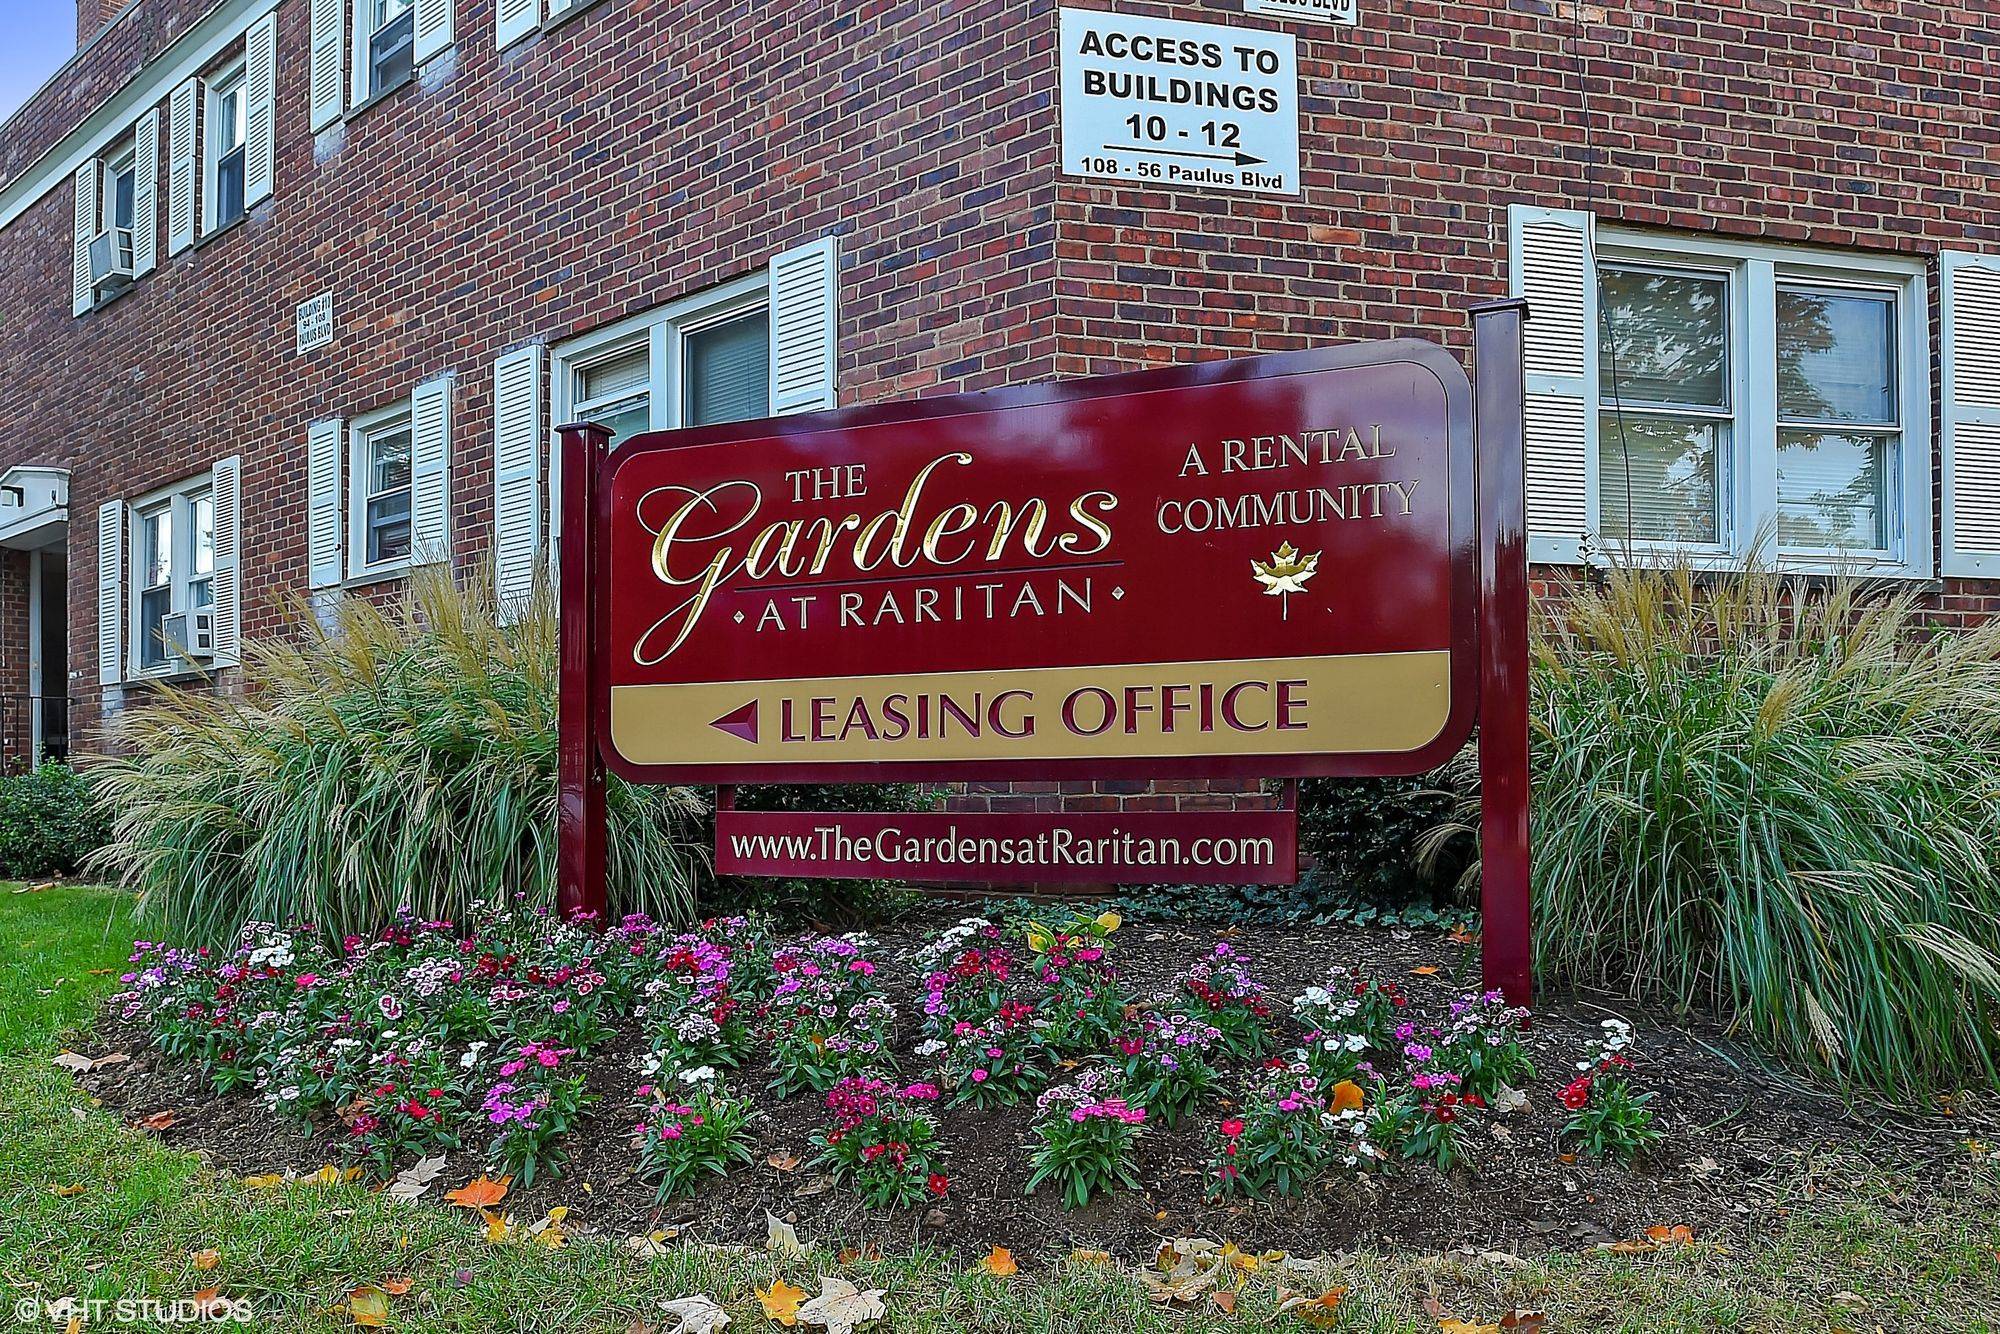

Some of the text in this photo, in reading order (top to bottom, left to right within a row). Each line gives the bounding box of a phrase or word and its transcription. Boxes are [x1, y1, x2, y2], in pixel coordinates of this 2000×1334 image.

[1079, 30, 1279, 74] ACCESS TO
[1083, 70, 1278, 113] BUILDINGS
[1126, 114, 1166, 142] 10
[1201, 121, 1240, 149] 12
[1081, 157, 1118, 175] 108
[1137, 163, 1161, 178] 56
[1168, 165, 1235, 185] Paulus
[1241, 172, 1282, 189] Blvd
[299, 322, 331, 347] PAULUS BLVD
[1178, 424, 1397, 477] A RENTAL
[784, 463, 868, 503] THE
[1157, 479, 1420, 534] COMMUNITY
[632, 451, 1119, 666] Gardens
[756, 577, 1093, 632] AT RARITAN
[780, 679, 1309, 743] LEASING OFFICE
[730, 825, 1275, 866] www.TheGardensatRaritan.com
